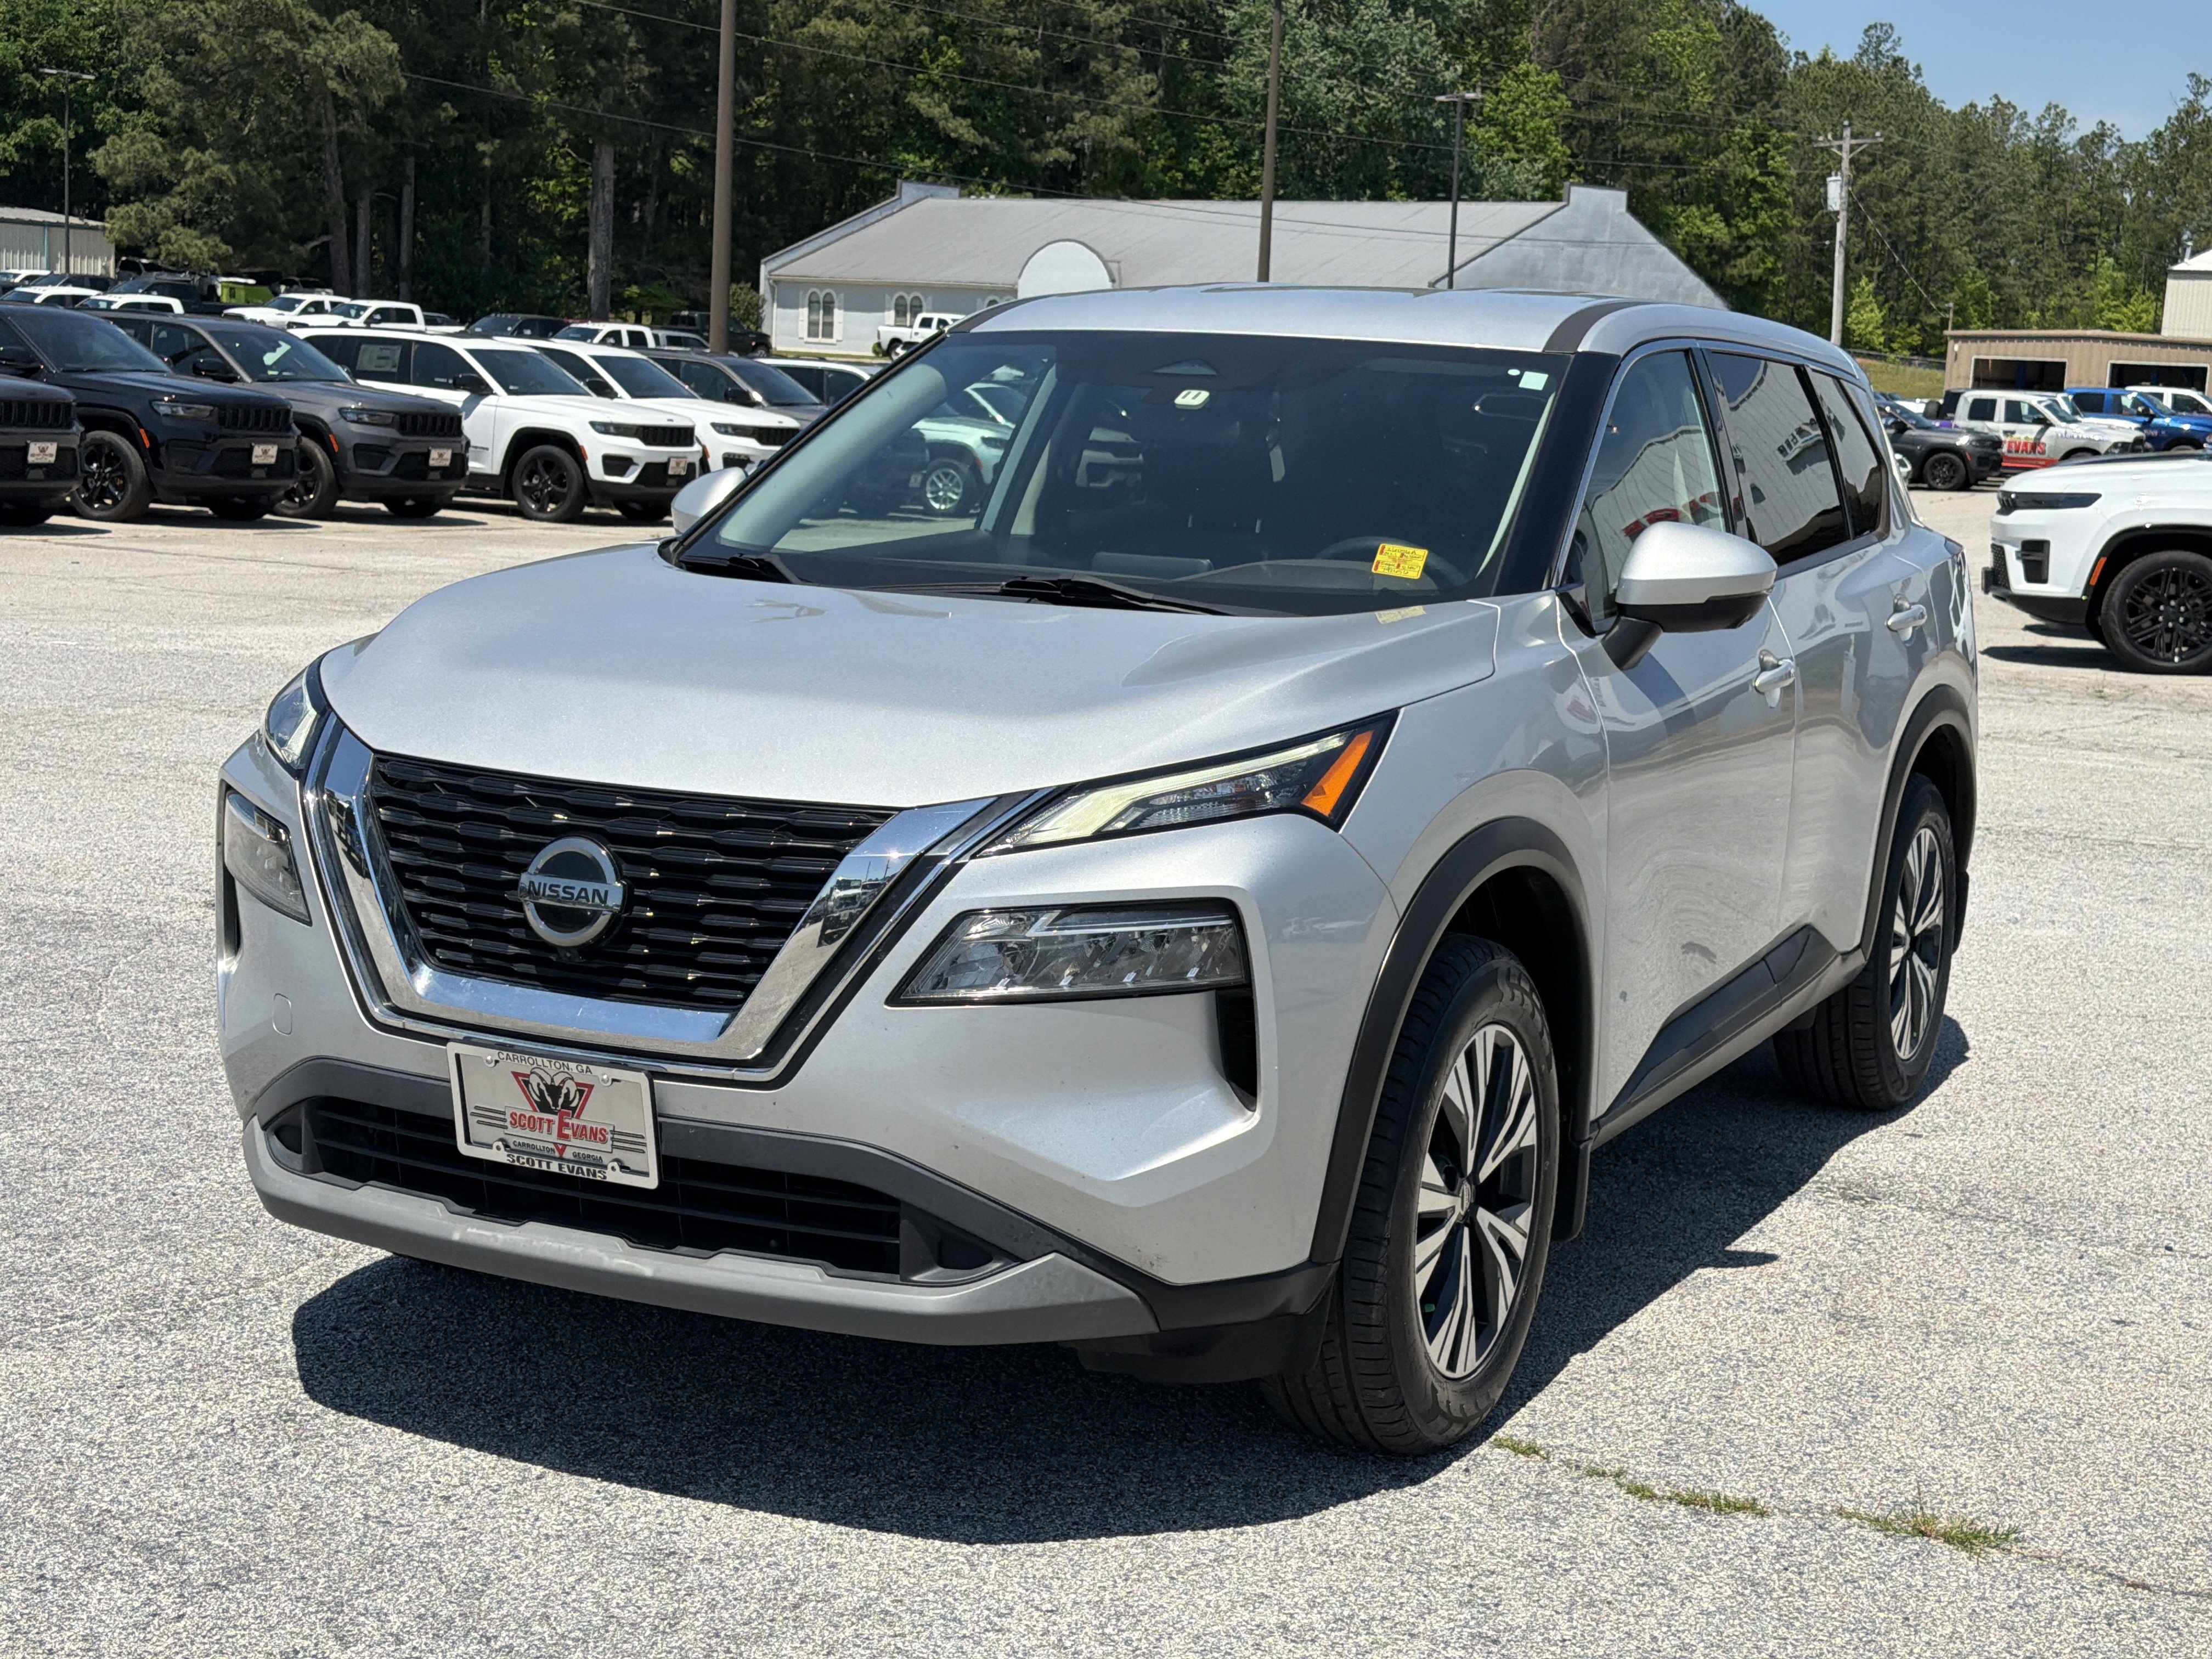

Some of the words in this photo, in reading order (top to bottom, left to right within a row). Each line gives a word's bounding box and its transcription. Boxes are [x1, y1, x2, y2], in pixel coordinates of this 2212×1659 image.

[2007, 440, 2046, 455] EVANS
[527, 880, 609, 905] NISSAN
[497, 1051, 573, 1072] CARROLLTON,
[576, 1064, 593, 1075] GA
[509, 1111, 555, 1133] SCOTT
[557, 1109, 608, 1144] EVANS
[512, 1139, 556, 1154] CARROLLTON
[572, 1150, 603, 1163] GEORGIA
[506, 1153, 553, 1170] SCOTT
[557, 1163, 608, 1180] EVANS
